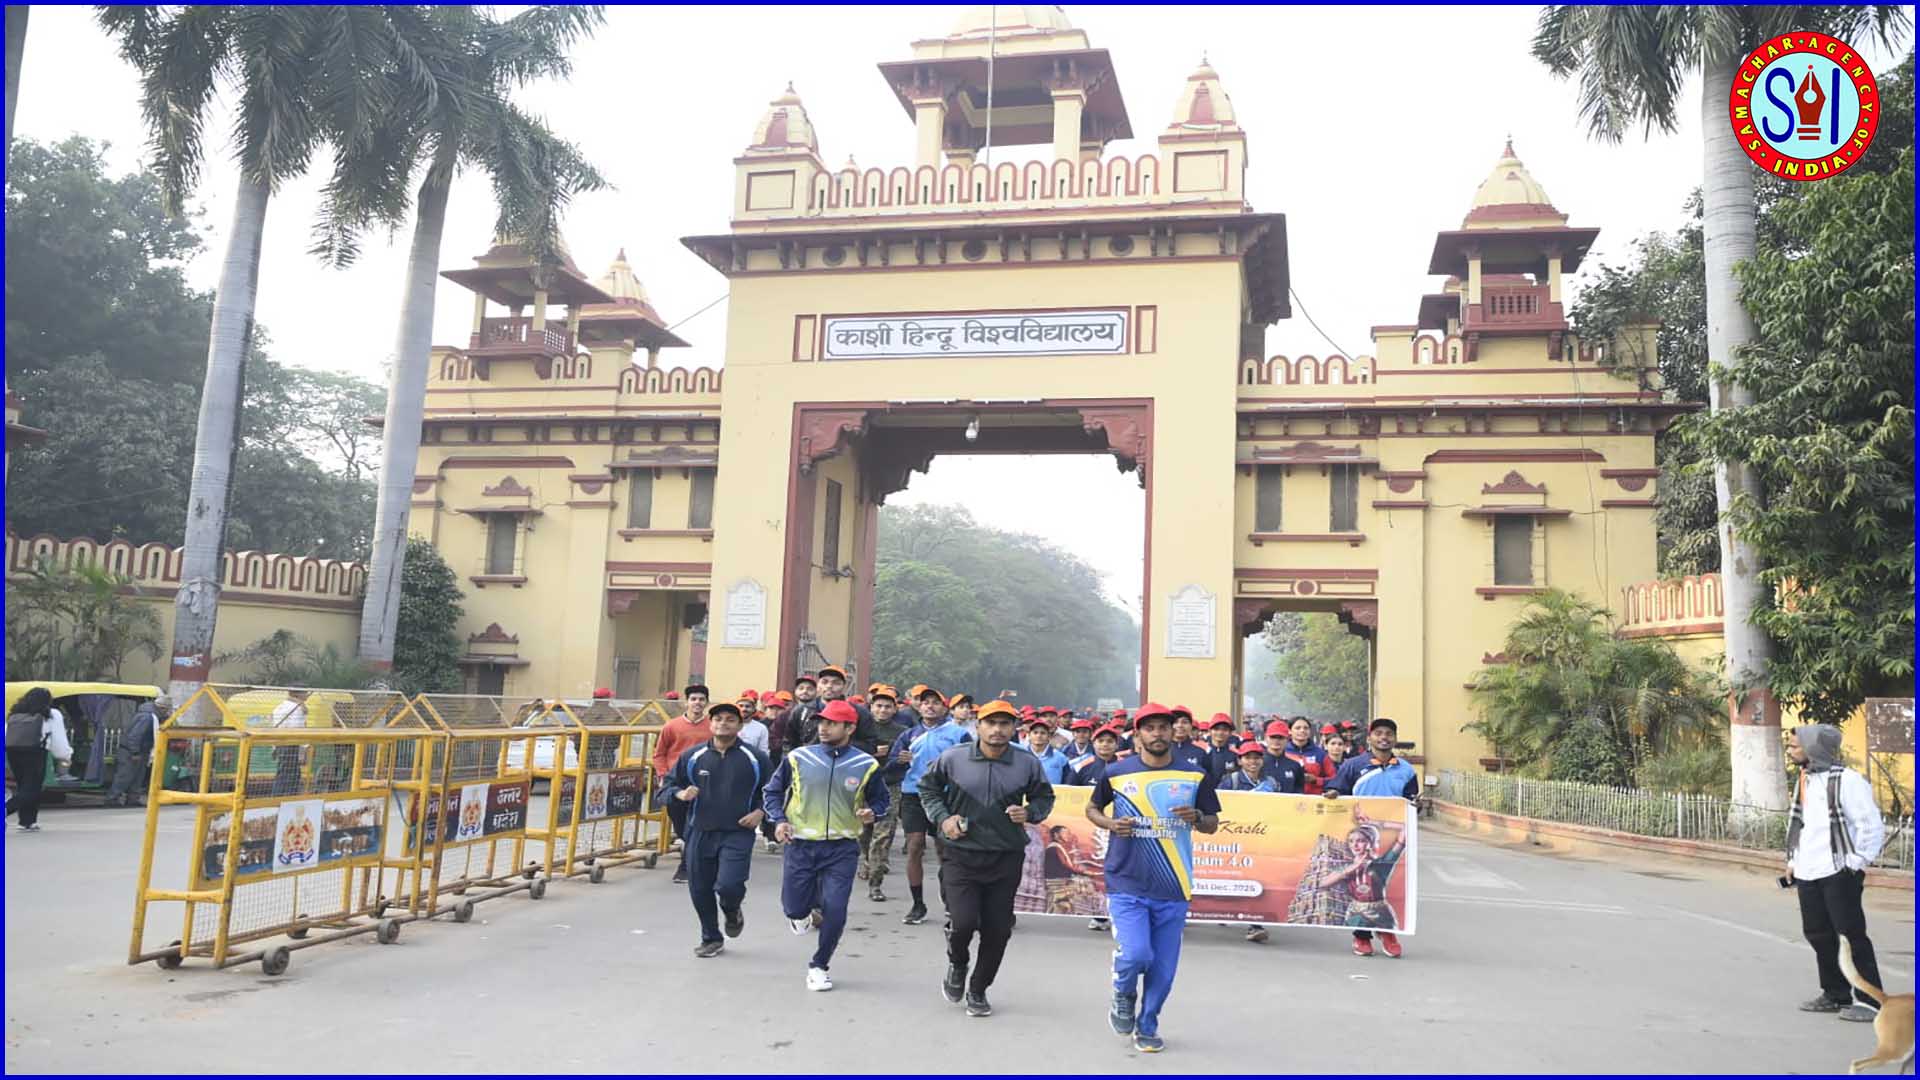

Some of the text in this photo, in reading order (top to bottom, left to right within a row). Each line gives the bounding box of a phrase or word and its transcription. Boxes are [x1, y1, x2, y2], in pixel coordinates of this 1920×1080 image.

[835, 319, 1117, 350] काशी हिन्दू विश्वविद्यालय
[1218, 820, 1267, 835] Kashi
[1227, 855, 1253, 869] 4.0
